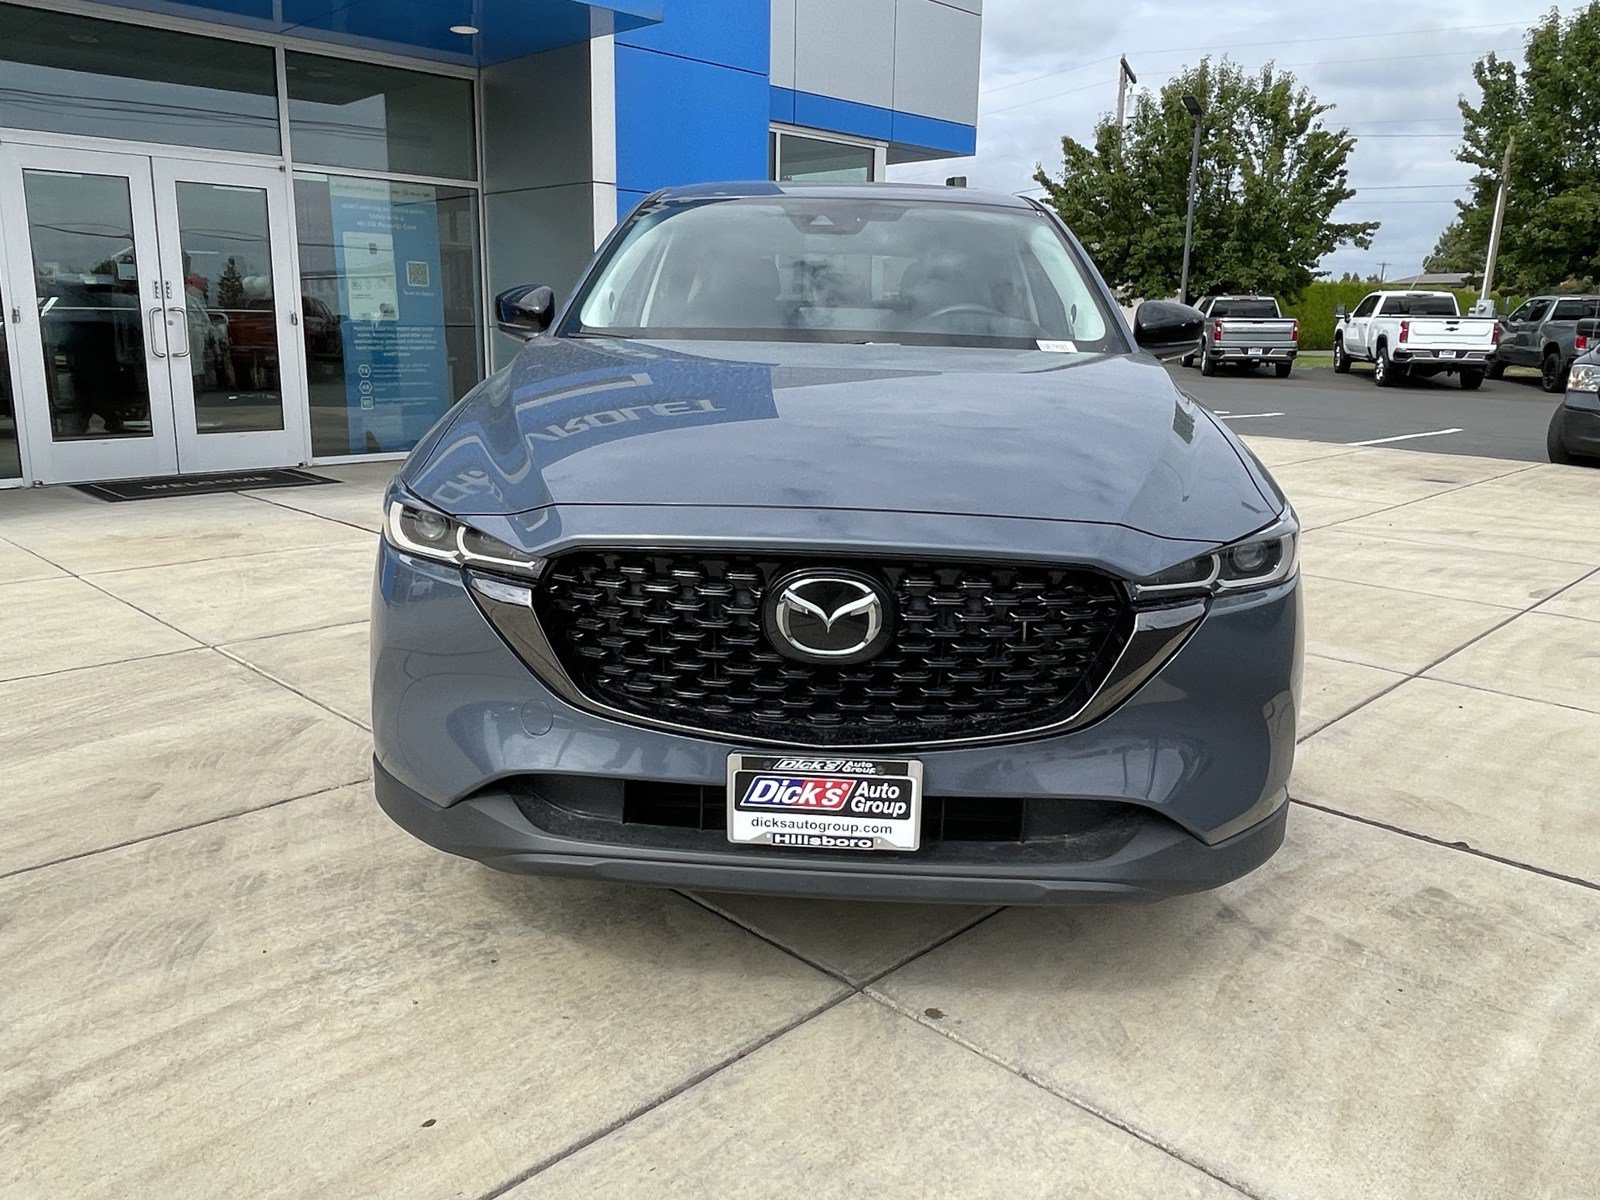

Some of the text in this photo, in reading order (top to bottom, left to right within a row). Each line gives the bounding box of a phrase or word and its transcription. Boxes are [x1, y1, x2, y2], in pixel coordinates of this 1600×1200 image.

[845, 761, 873, 769] Auto
[749, 780, 900, 806] Dick's Auto
[851, 797, 907, 817] Group
[751, 817, 893, 835] dicksautogroup.com
[774, 834, 873, 848] Hillsboro
